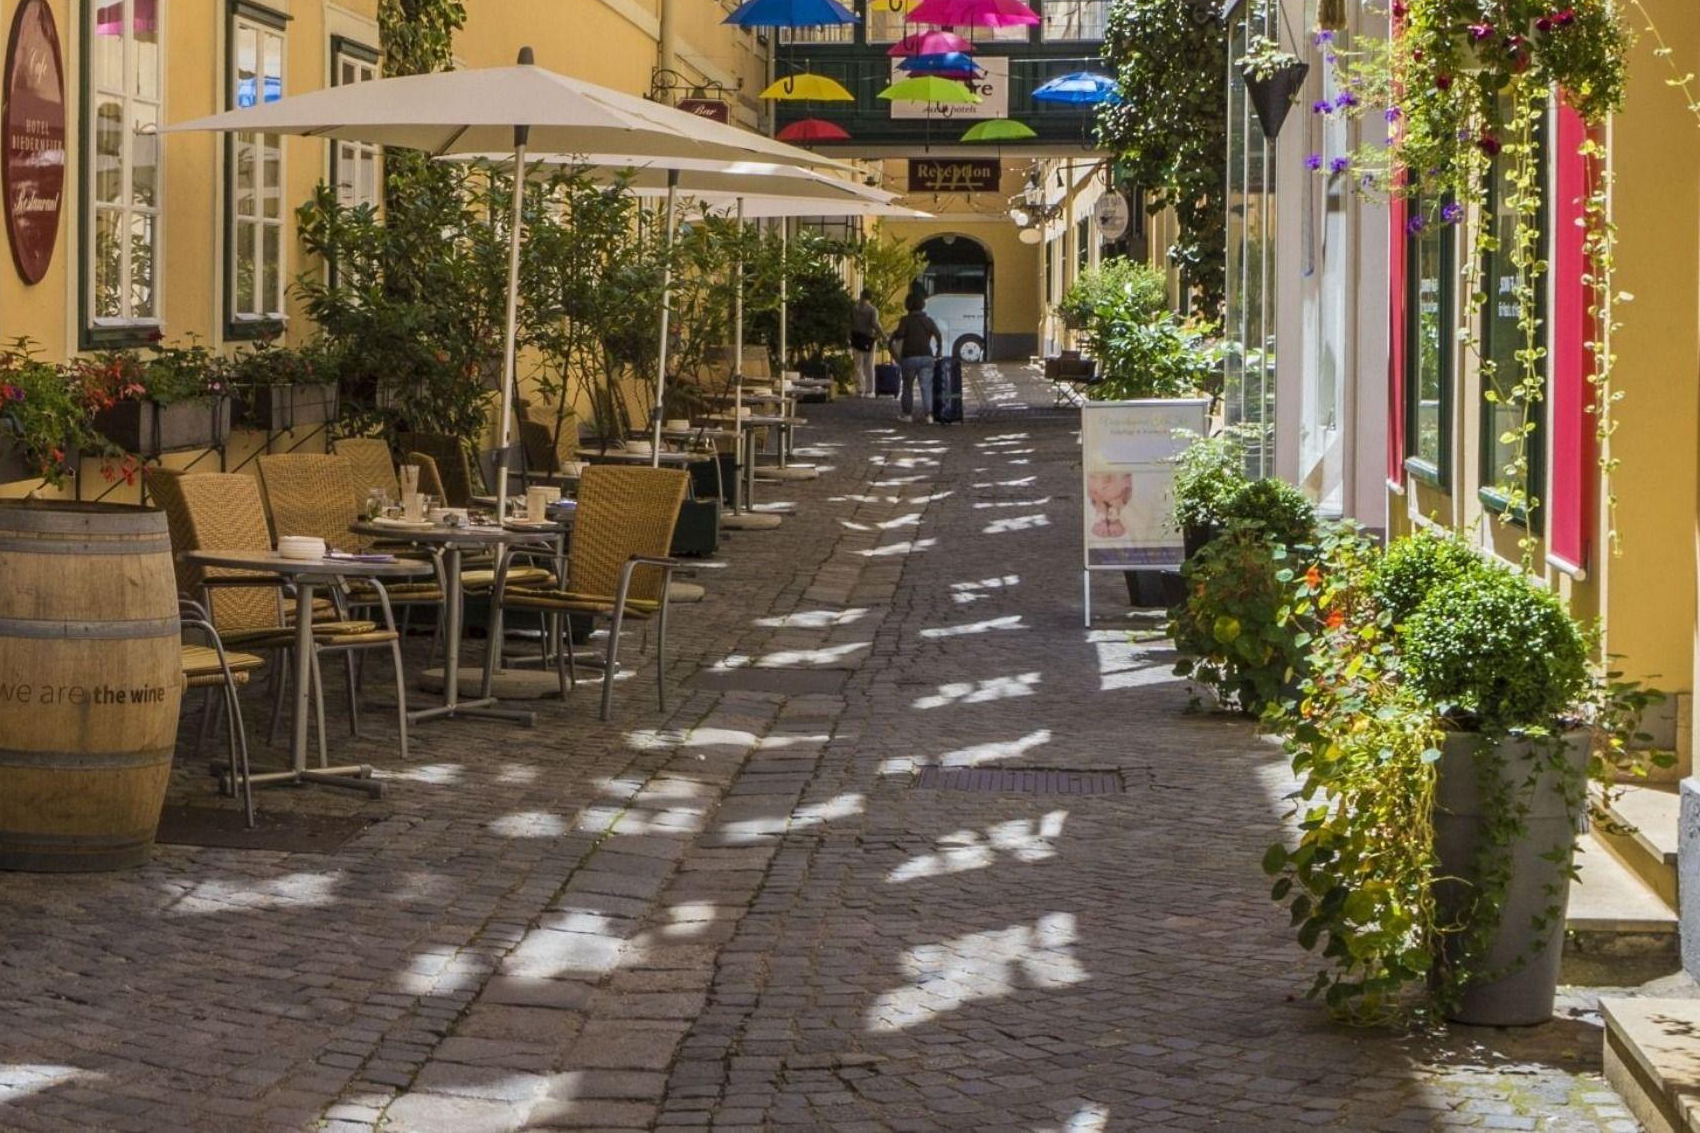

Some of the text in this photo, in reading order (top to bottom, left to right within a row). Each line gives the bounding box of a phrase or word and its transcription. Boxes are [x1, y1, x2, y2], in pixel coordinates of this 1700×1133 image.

[25, 118, 50, 136] HOTEL
[917, 163, 991, 180] Reception
[40, 683, 85, 706] are
[93, 684, 126, 704] the
[130, 684, 166, 704] wine
